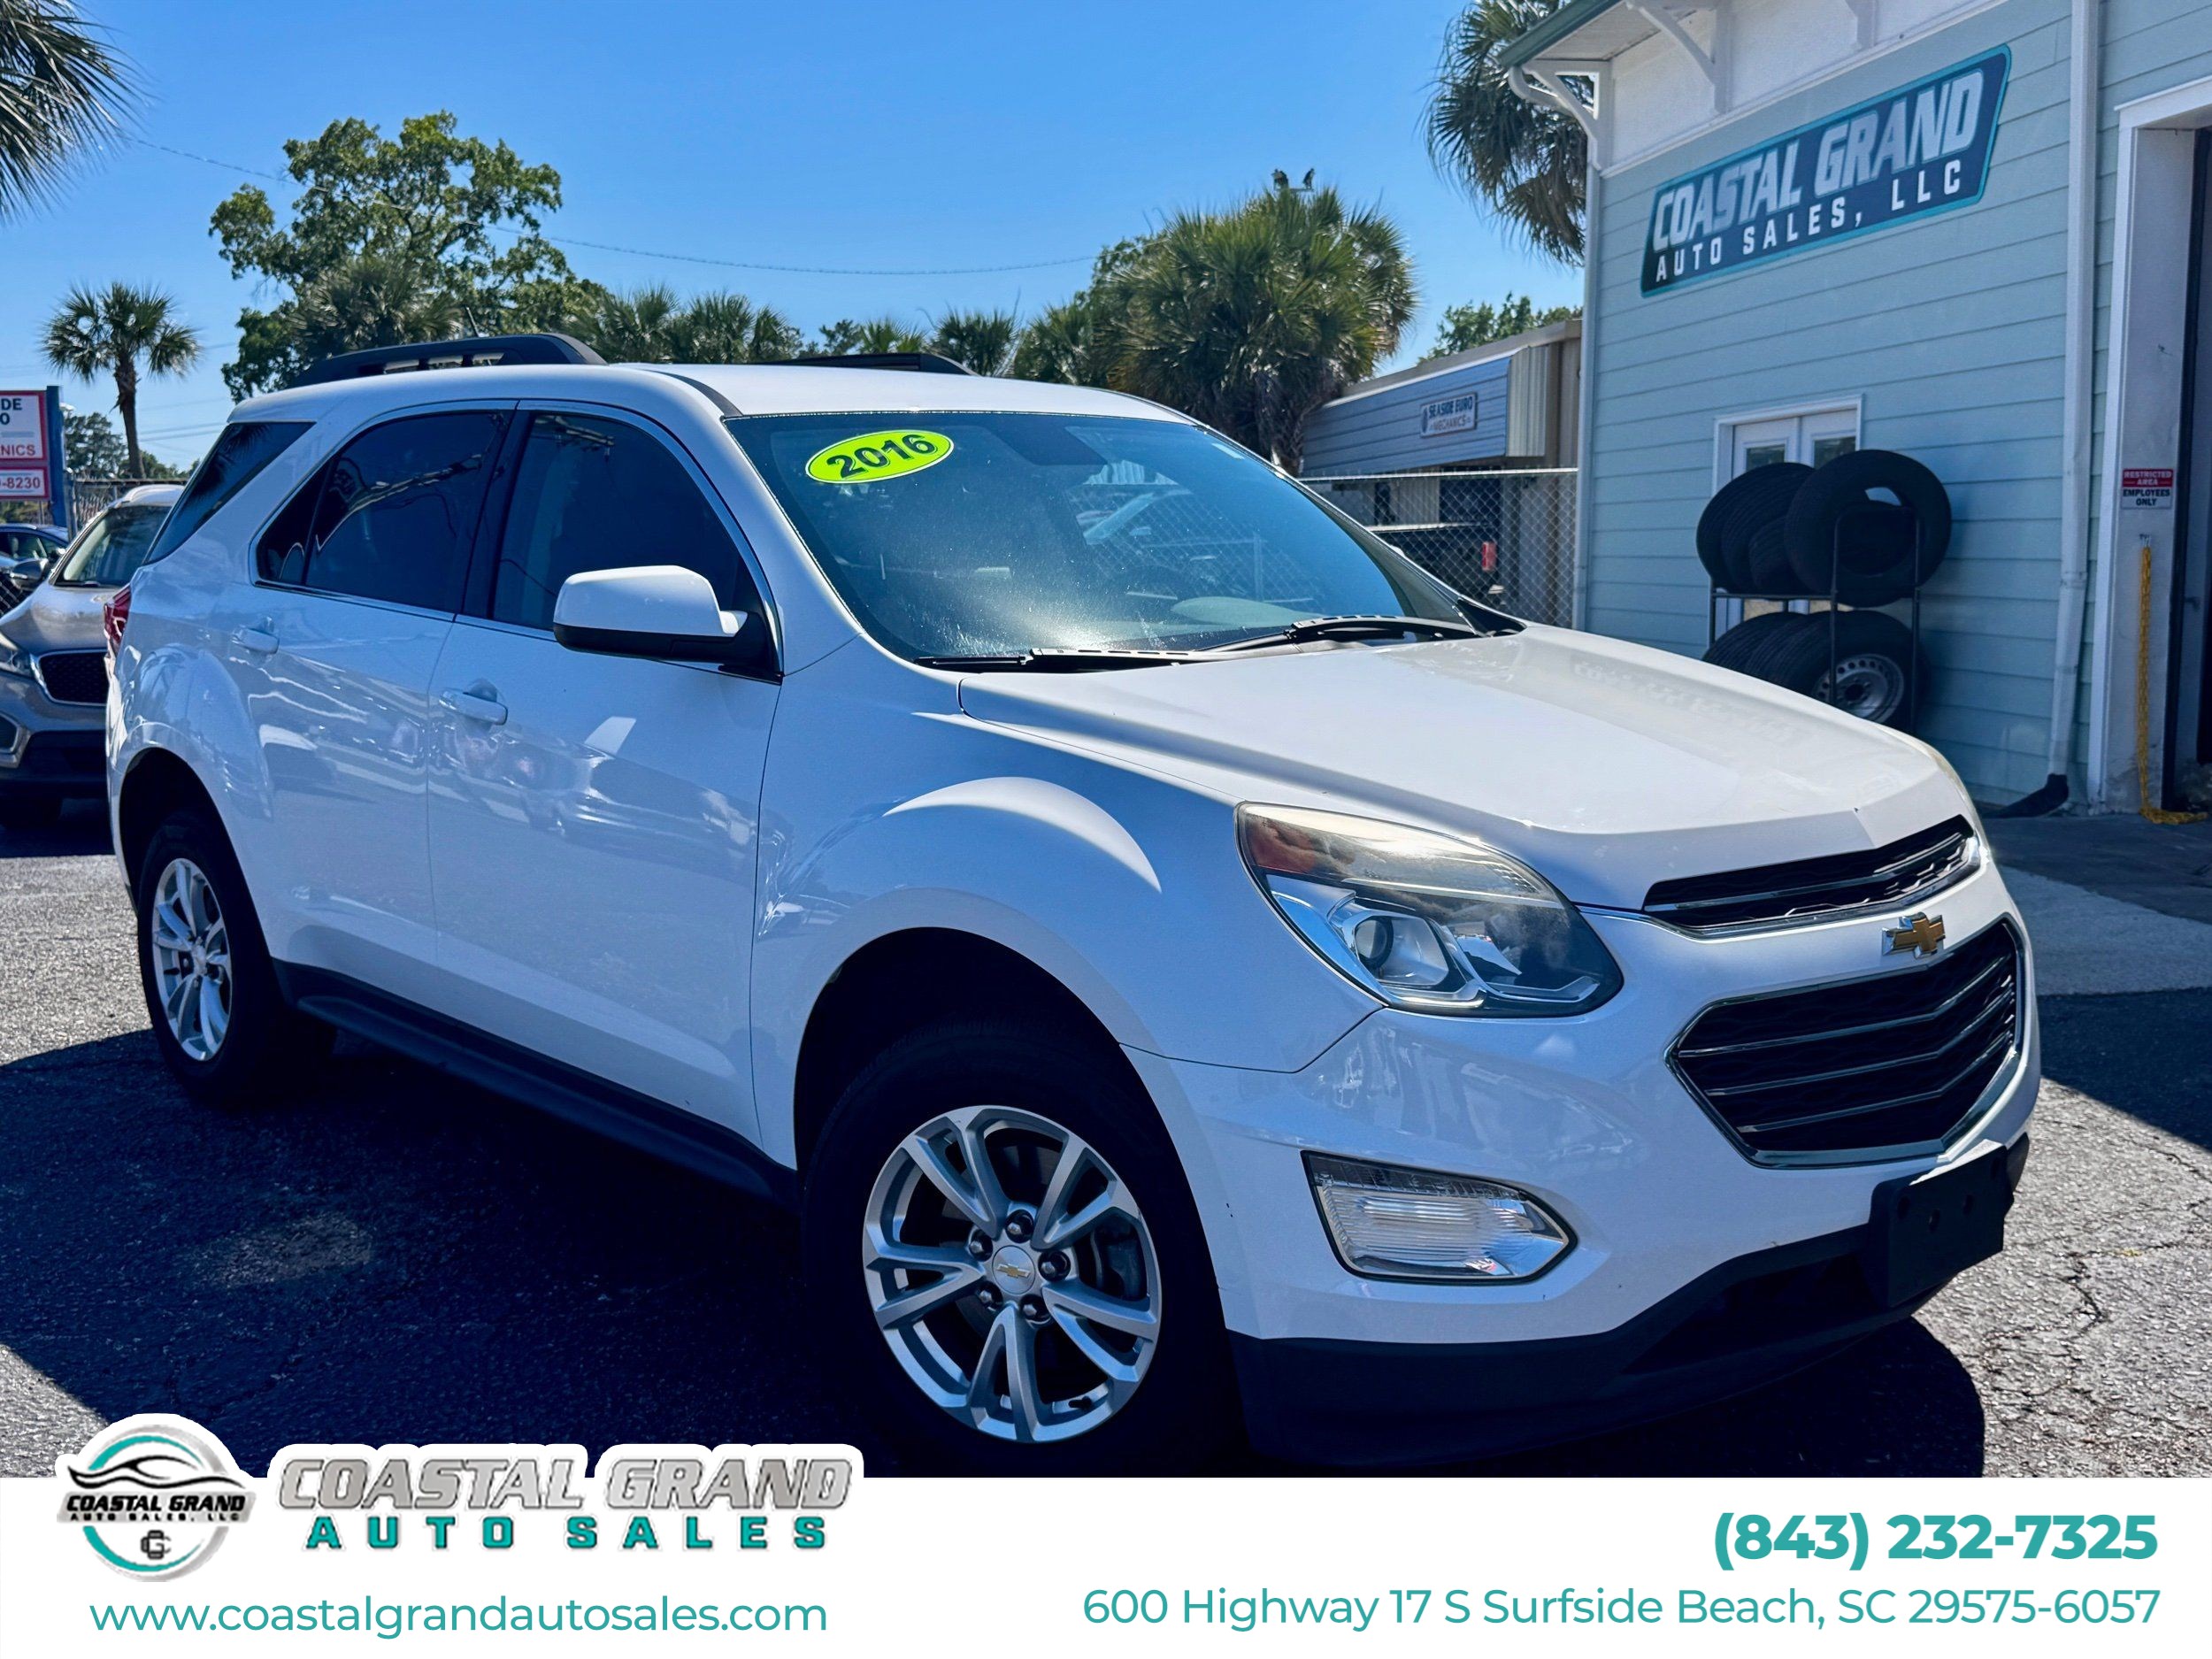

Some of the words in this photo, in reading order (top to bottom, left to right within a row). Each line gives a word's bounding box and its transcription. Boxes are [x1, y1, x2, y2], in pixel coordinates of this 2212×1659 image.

[1653, 141, 1802, 252] COASTAL
[1813, 68, 1985, 197] GRAND
[1655, 237, 1722, 282] AUTO
[1742, 196, 1863, 255] SALES,
[1428, 400, 1455, 419] SEASIDE
[1455, 396, 1473, 413] EURO
[826, 434, 938, 479] 2016
[0, 478, 41, 489] -8230
[2124, 488, 2170, 497] EMPLOYEES
